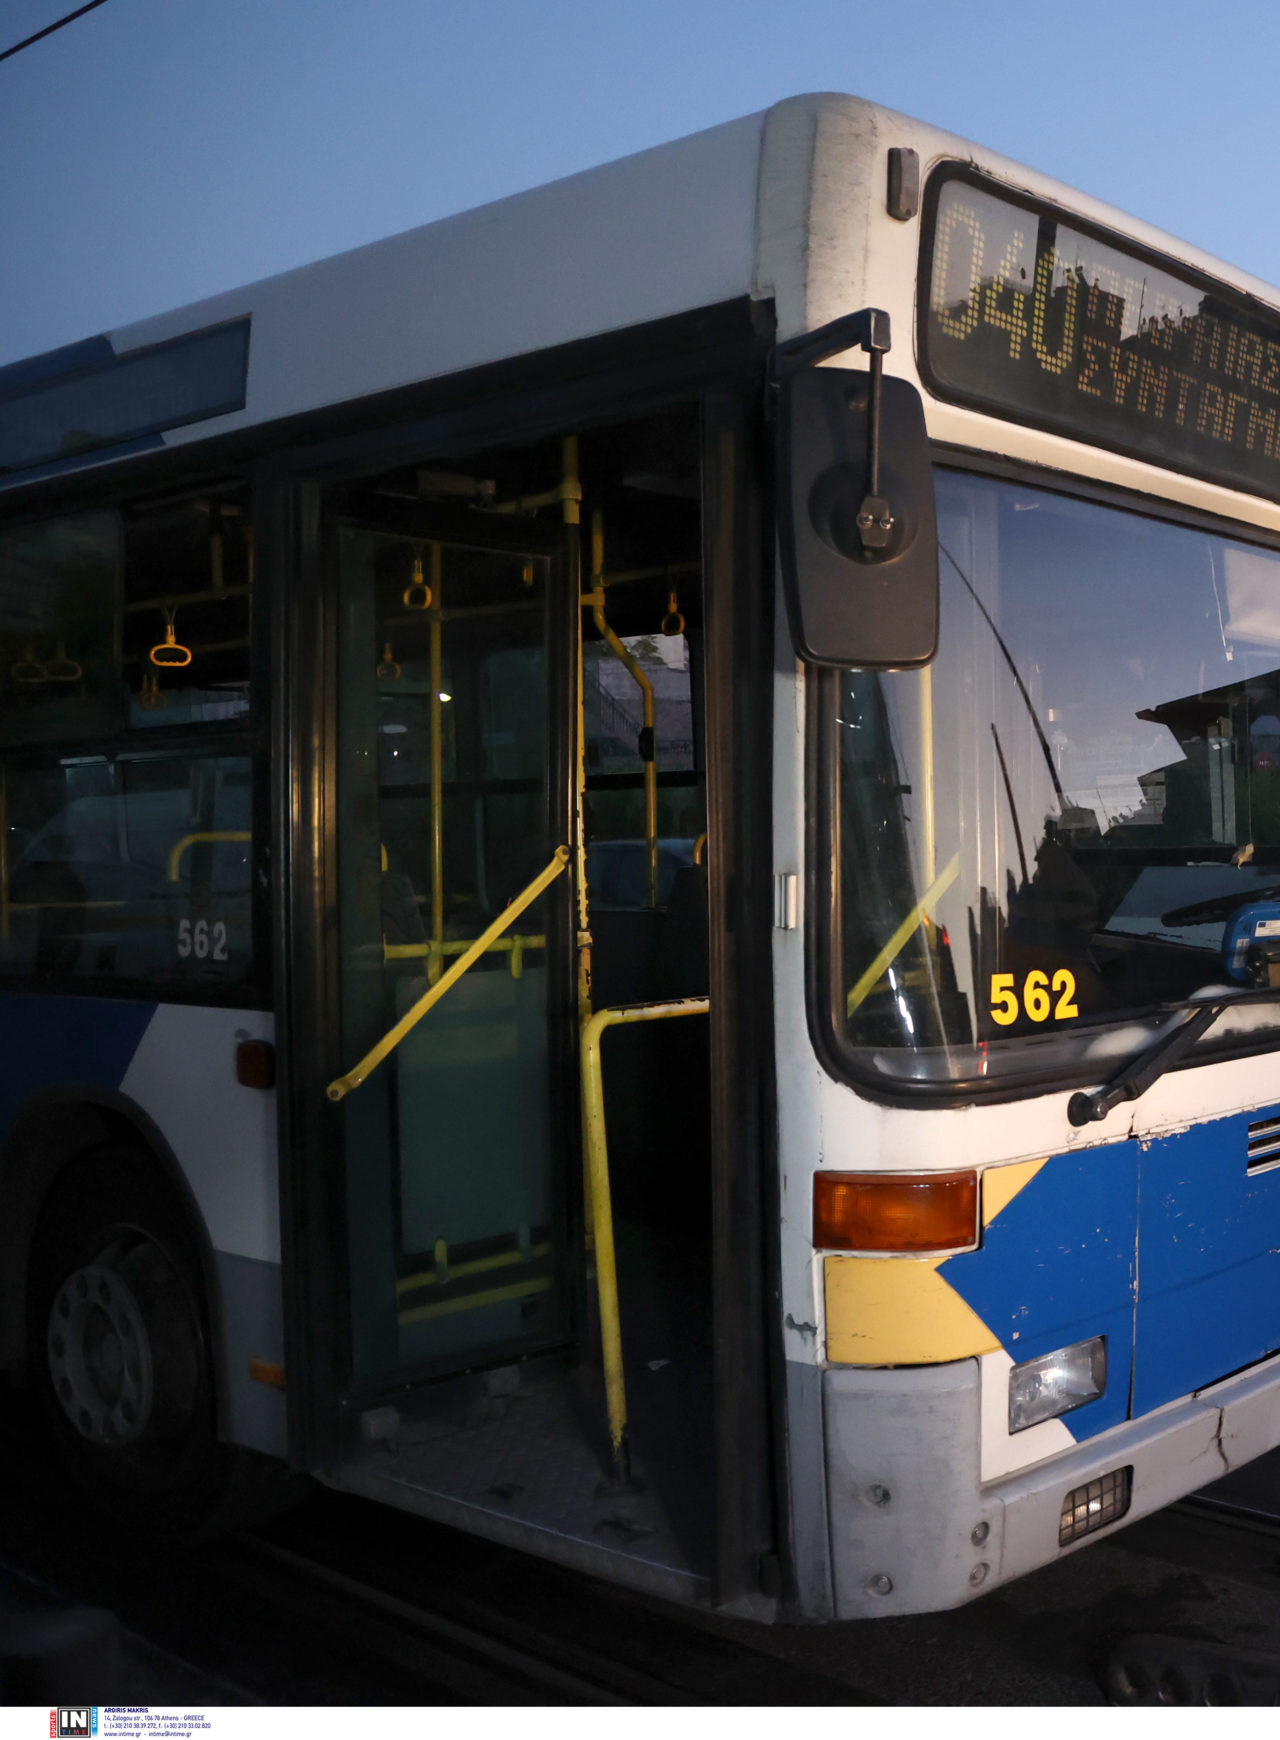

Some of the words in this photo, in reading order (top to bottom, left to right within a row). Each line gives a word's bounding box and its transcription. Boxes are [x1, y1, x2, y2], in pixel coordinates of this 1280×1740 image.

[934, 202, 1078, 376] 040
[177, 918, 229, 961] 562
[990, 968, 1079, 1026] 562
